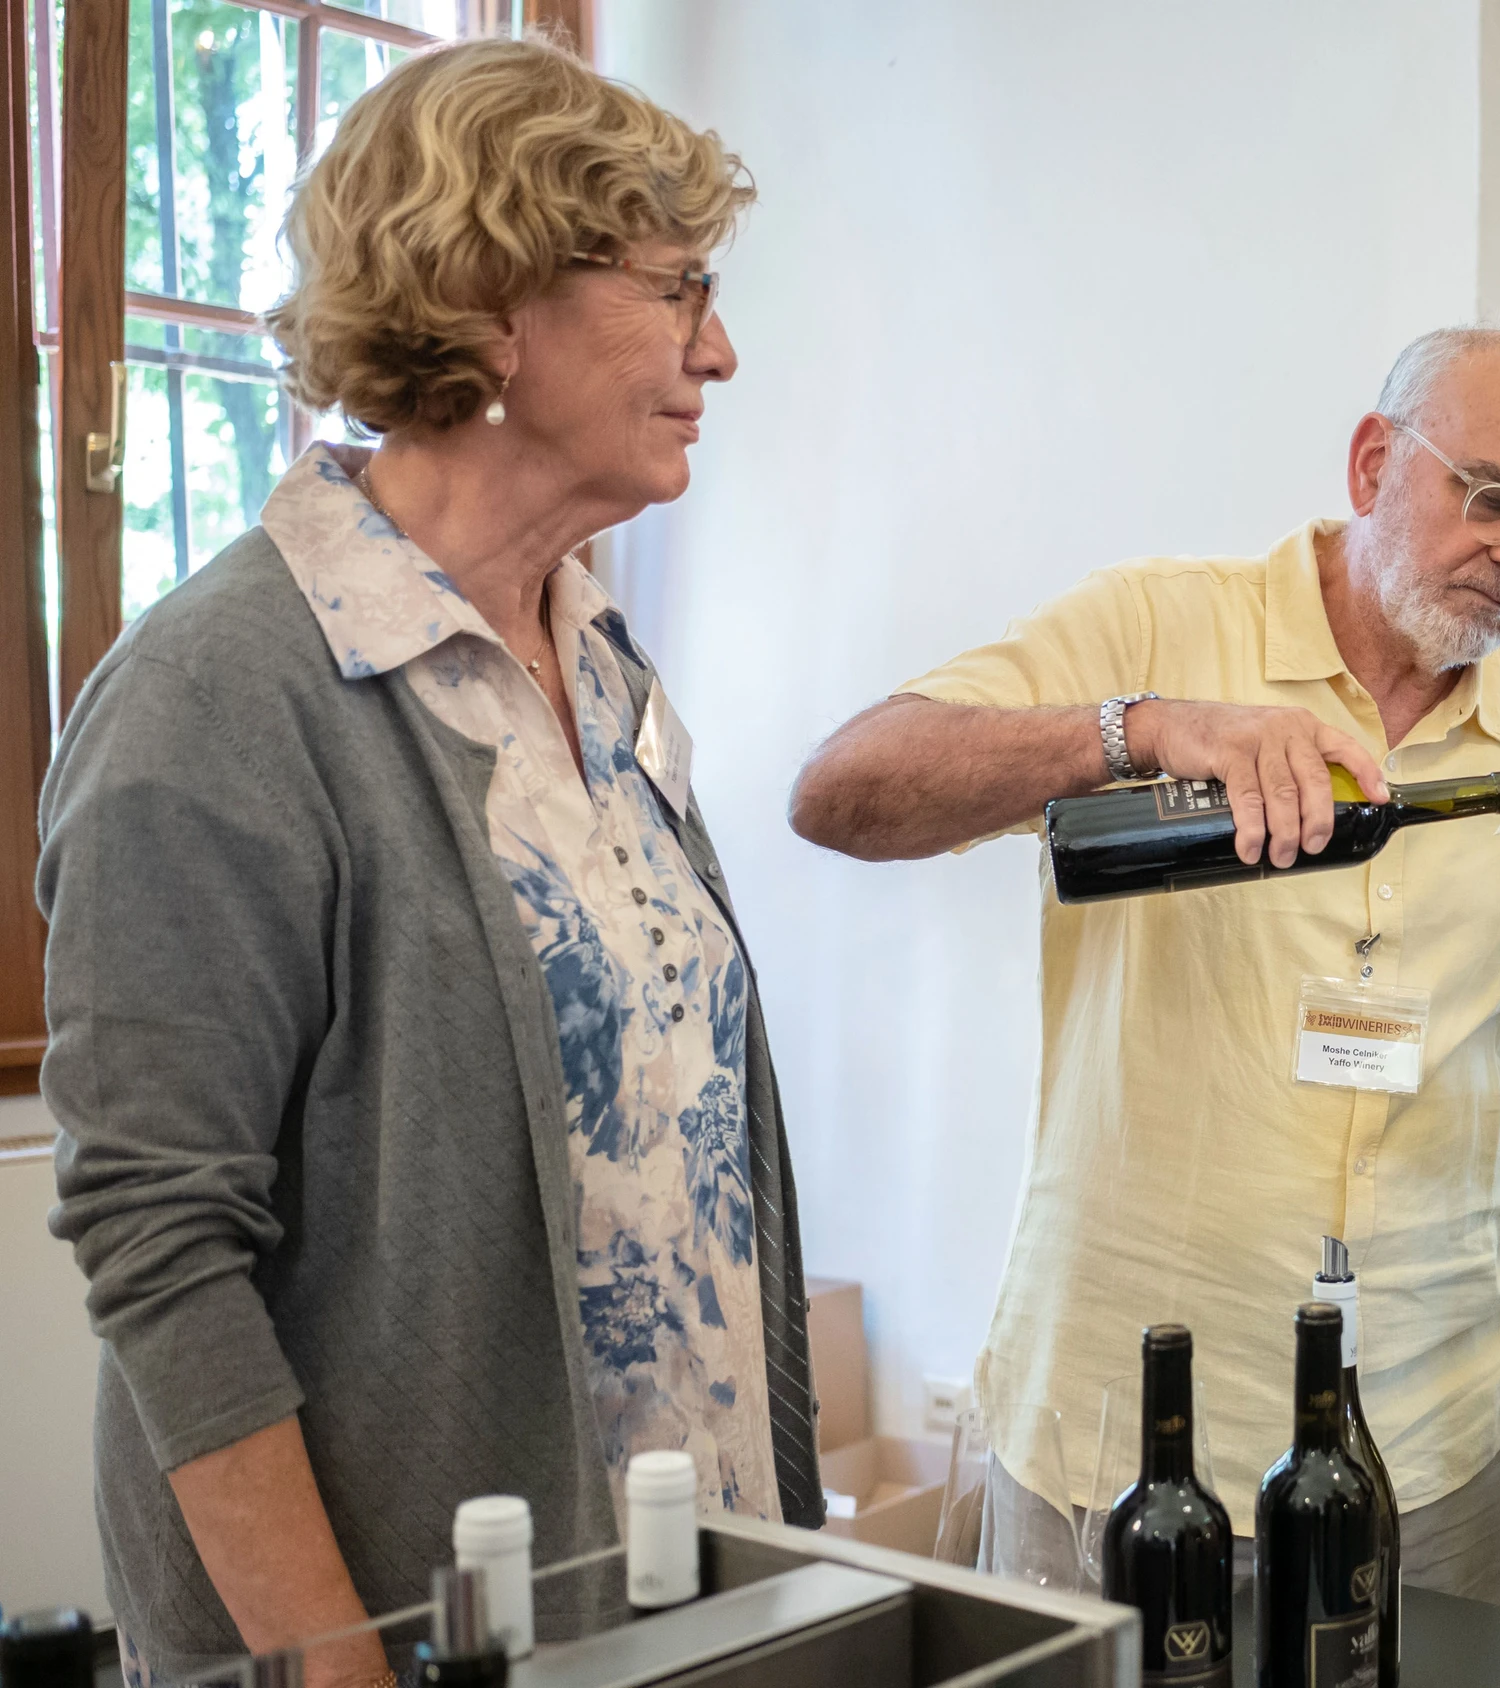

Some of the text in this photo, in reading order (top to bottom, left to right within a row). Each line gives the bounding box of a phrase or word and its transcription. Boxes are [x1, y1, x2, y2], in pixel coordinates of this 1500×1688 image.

[1322, 1045, 1351, 1056] Moshe
[1328, 1057, 1385, 1073] Yaffo Winery
